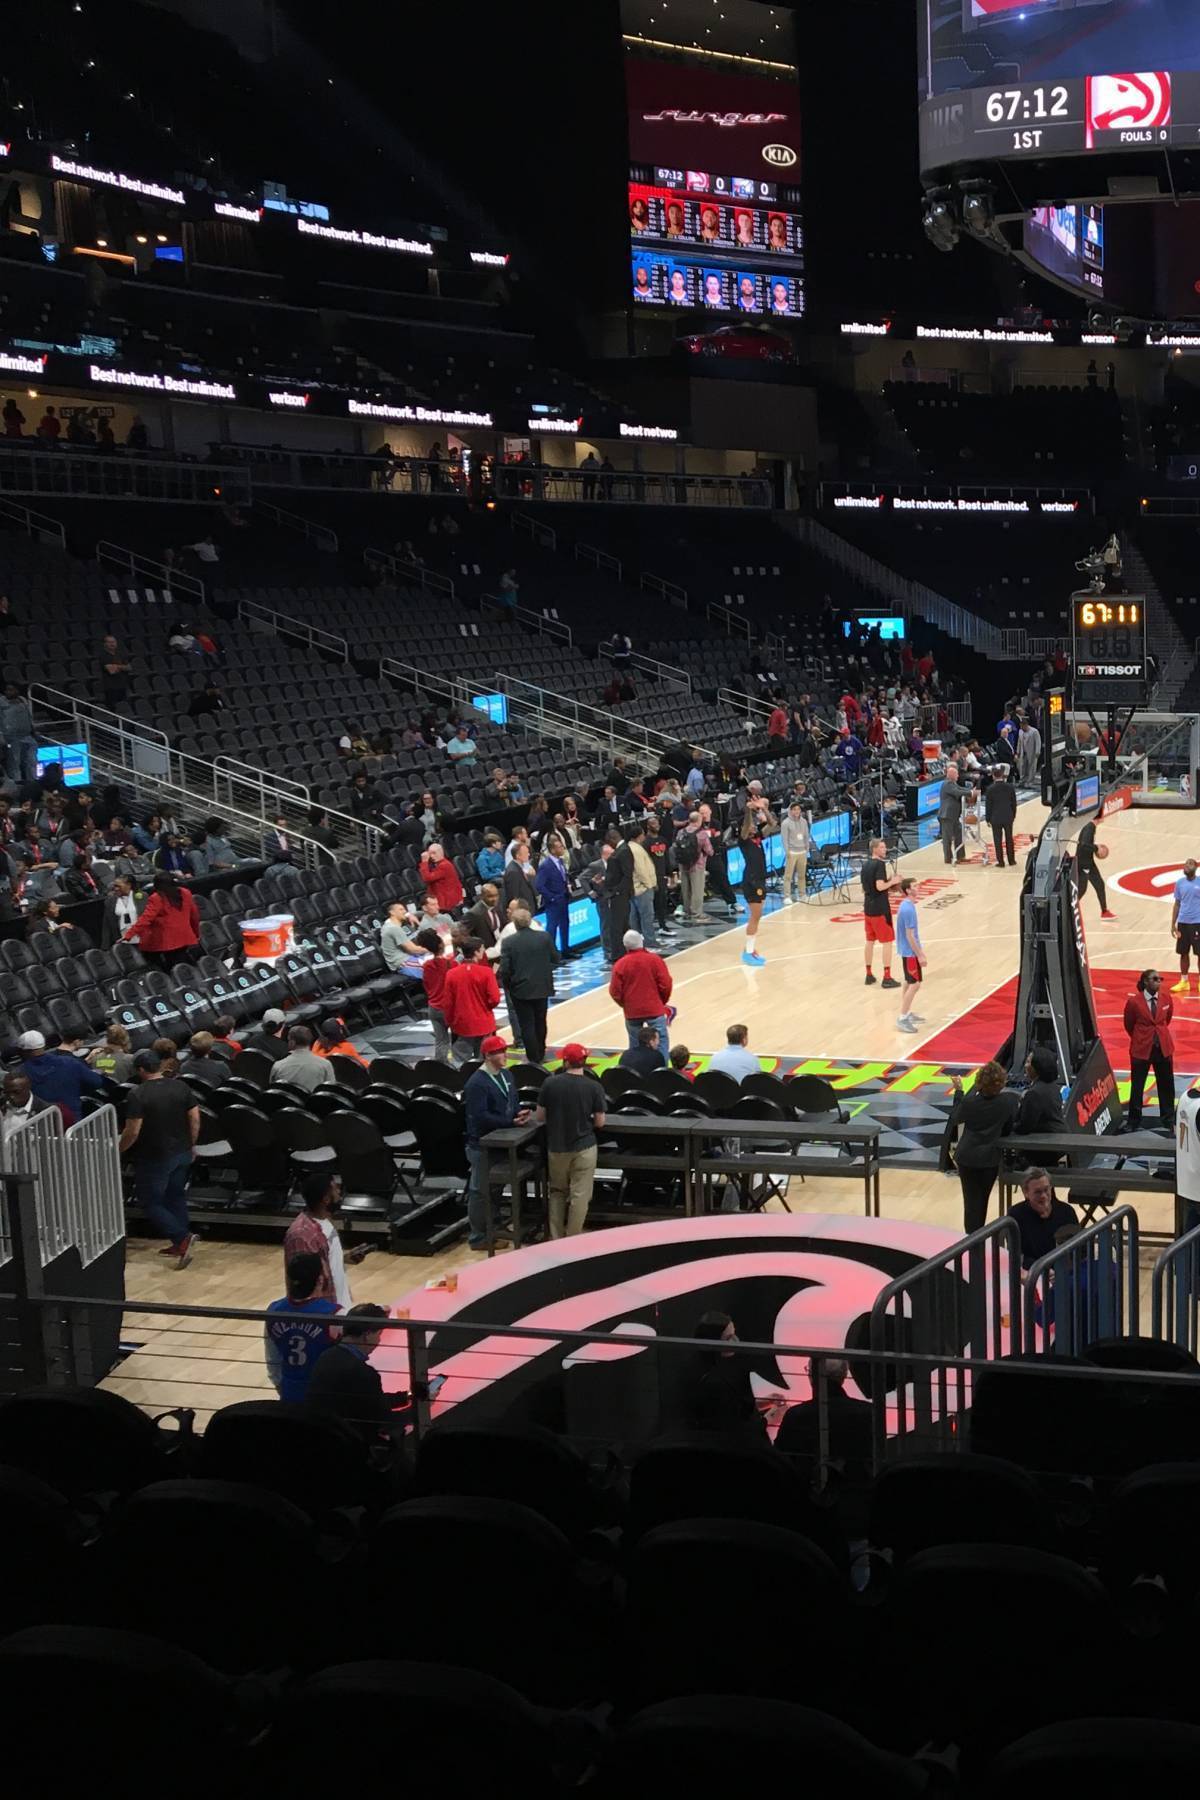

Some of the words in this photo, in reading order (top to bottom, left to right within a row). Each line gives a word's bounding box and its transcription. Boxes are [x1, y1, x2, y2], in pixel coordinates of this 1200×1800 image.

[986, 86, 1068, 122] 67:12
[1013, 130, 1042, 149] 1ST
[1120, 131, 1152, 142] FOULS
[1160, 131, 1167, 141] 0
[768, 148, 790, 162] KIA
[52, 156, 75, 174] Best
[76, 165, 119, 186] network.
[119, 174, 141, 192] Best
[141, 183, 185, 204] unlimited.
[658, 168, 683, 180] 67:12
[716, 177, 724, 190] 0
[760, 182, 769, 195] 0
[215, 203, 260, 222] unlimited
[298, 219, 319, 235] Best
[319, 227, 362, 242] network.
[362, 232, 386, 247] Best
[386, 238, 433, 255] unlimited.
[470, 252, 505, 265] verizon
[841, 323, 885, 334] unlimited
[917, 326, 940, 338] Best
[940, 329, 983, 340] network.
[983, 329, 1006, 340] Best
[1006, 331, 1054, 343] unlimited.
[90, 365, 116, 384] Best
[117, 371, 164, 390] network.
[164, 376, 188, 392] Best
[188, 381, 235, 398] unlimited.
[269, 392, 306, 407] verizon
[349, 400, 372, 415] Best
[372, 404, 416, 419] network.
[416, 406, 441, 420] Best
[441, 411, 493, 425] unlimited.
[528, 418, 578, 432] unlimited
[620, 424, 643, 436] Best
[833, 497, 880, 507] unlimited
[893, 498, 915, 508] Best
[916, 500, 957, 510] network.
[957, 500, 981, 510] Best
[981, 501, 1029, 511] unlimited.
[1041, 502, 1074, 511] verizon
[1082, 603, 1137, 624] 67:11
[1096, 665, 1141, 675] TISSOT
[288, 1335, 307, 1366] 3
